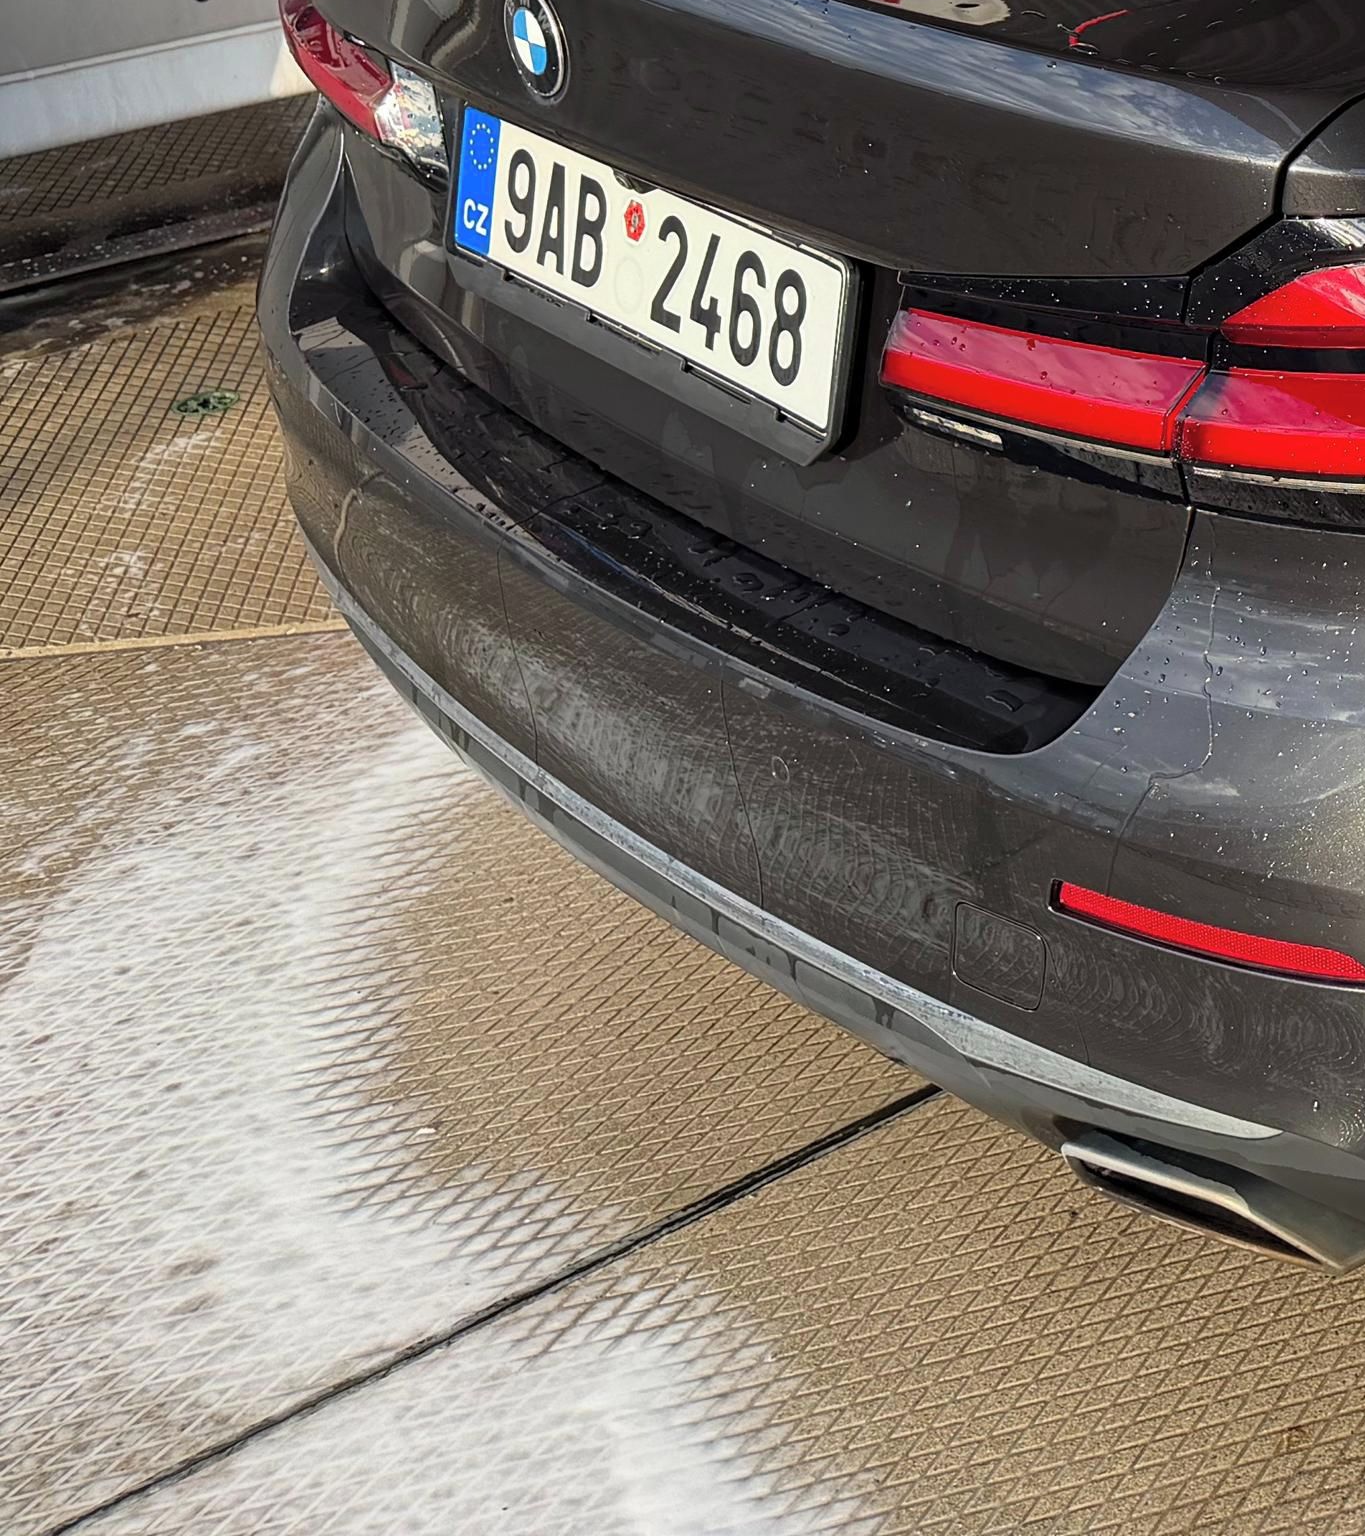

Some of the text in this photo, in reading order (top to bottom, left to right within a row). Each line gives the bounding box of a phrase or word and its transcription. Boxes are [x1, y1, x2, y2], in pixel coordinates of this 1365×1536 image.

[463, 198, 489, 236] CZ
[504, 149, 807, 387] 9AB 2468
